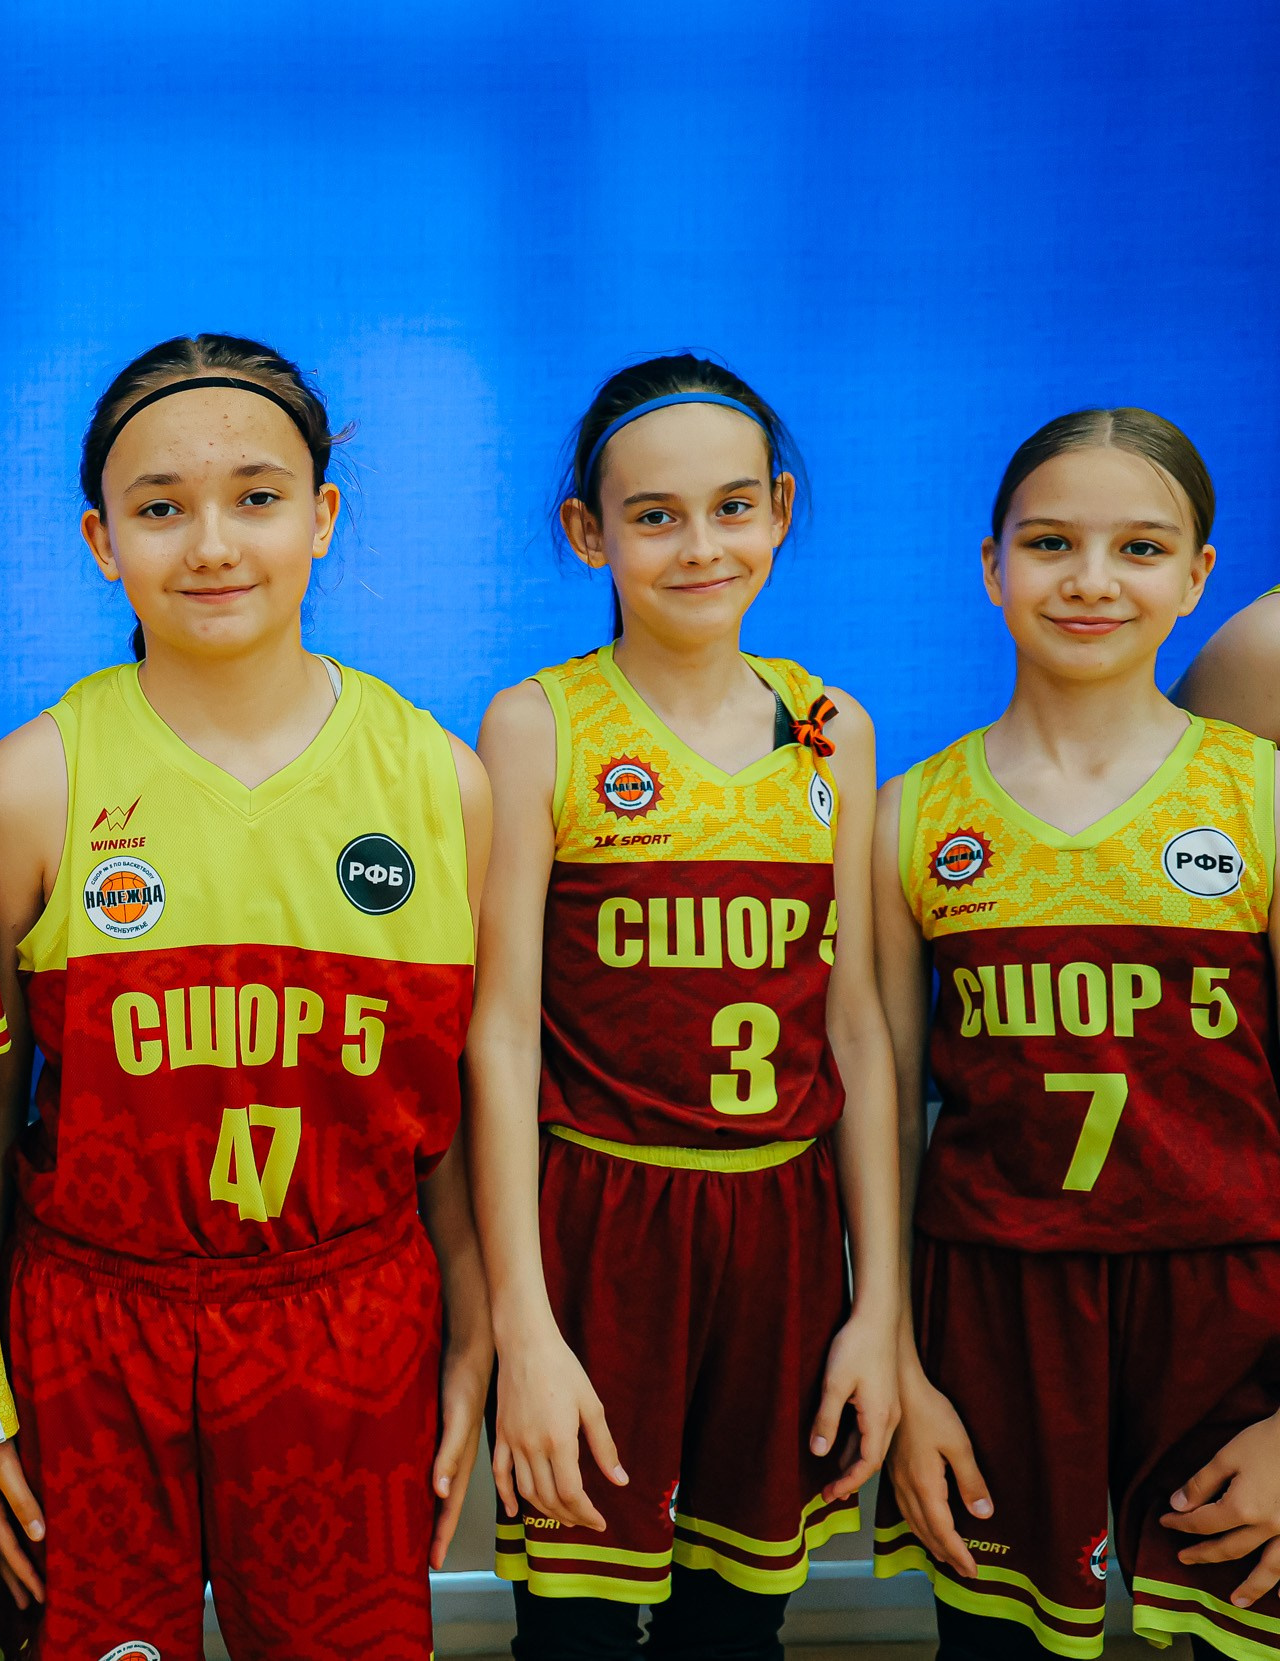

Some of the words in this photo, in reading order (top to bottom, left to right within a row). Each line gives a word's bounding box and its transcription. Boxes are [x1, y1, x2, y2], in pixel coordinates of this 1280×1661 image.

[91, 836, 146, 852] WINRISE
[620, 834, 672, 846] SPORT
[1176, 852, 1234, 874] РФБ
[85, 884, 163, 909] НАДЕЖДА
[349, 862, 403, 887] РФБ
[597, 895, 810, 970] СШОР
[950, 901, 997, 916] SPORT
[952, 961, 1162, 1038] СШОР
[1189, 967, 1238, 1039] 5
[111, 983, 325, 1076] СШОР
[341, 993, 389, 1077] 5
[710, 1002, 779, 1115] 3
[1044, 1073, 1129, 1192] 7
[209, 1104, 301, 1222] 47
